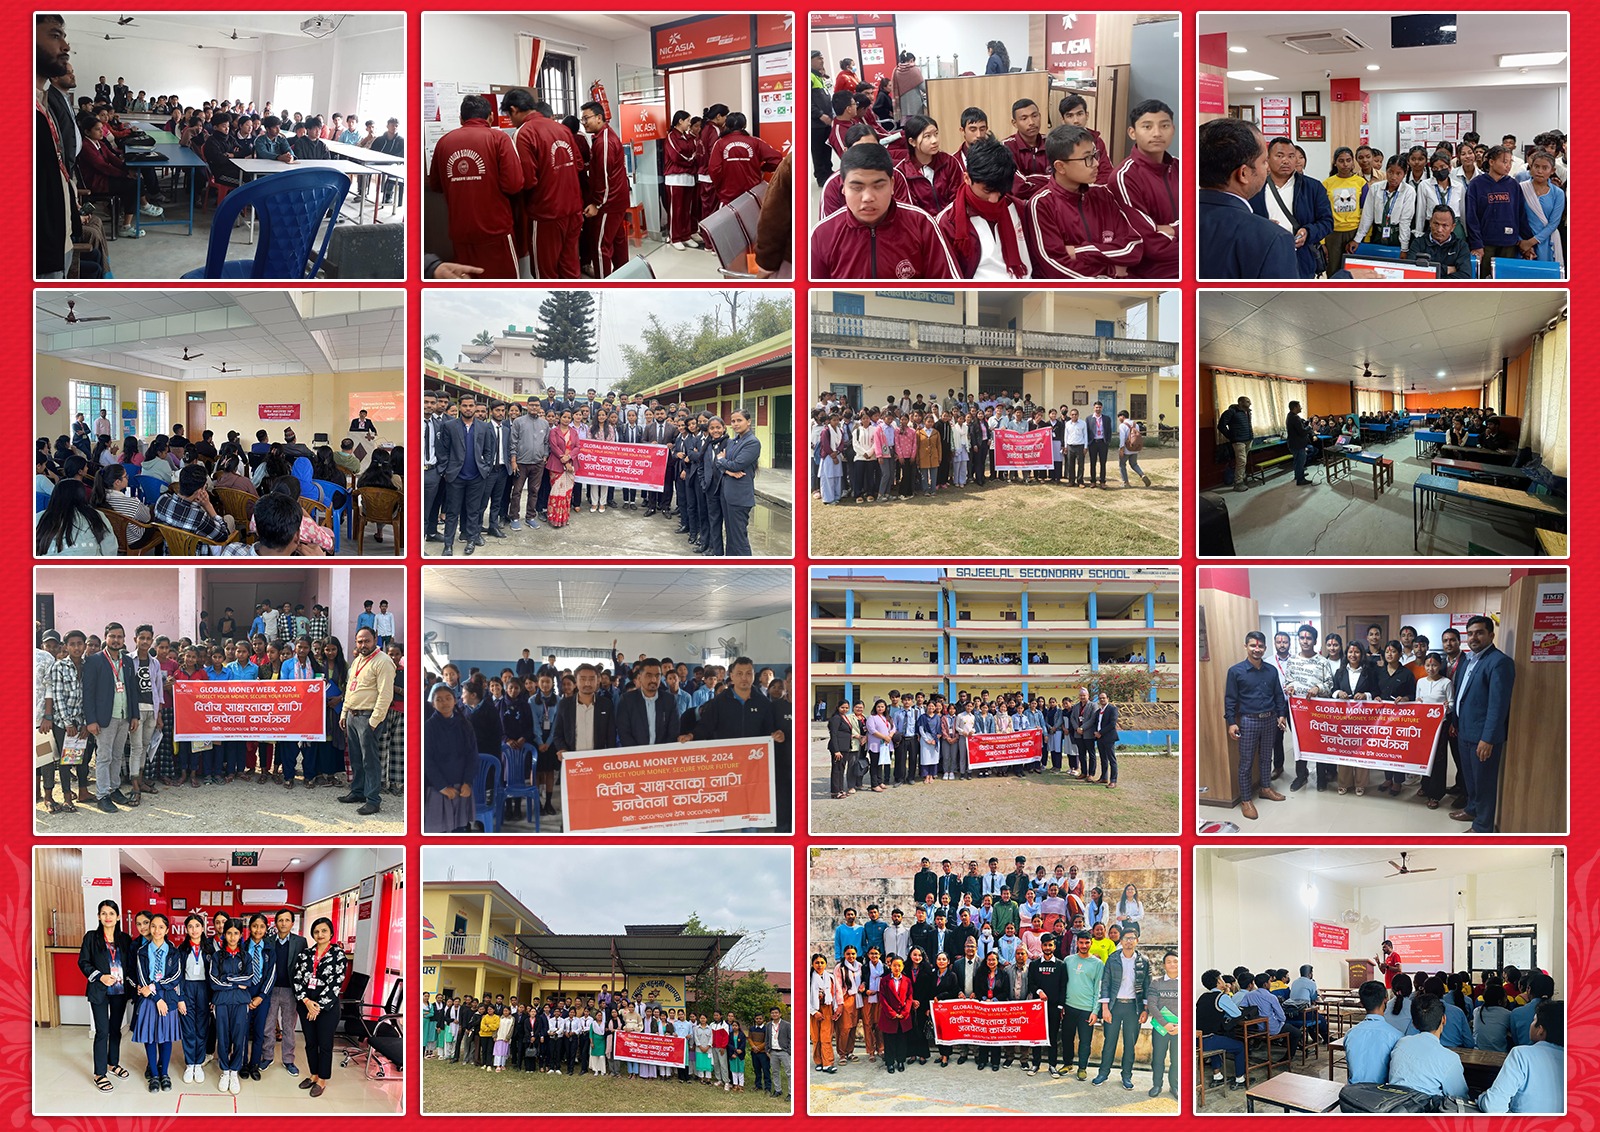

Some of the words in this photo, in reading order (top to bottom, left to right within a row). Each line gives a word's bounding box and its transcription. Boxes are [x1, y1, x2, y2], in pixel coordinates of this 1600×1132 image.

[660, 46, 672, 55] NIC
[674, 42, 696, 52] ASIA
[1052, 41, 1066, 55] NIC
[1066, 38, 1092, 54] ASIA
[634, 124, 644, 133] NIC
[644, 122, 657, 131] ASIA
[821, 348, 838, 358] श्री
[906, 354, 960, 365] माध्यमिक
[956, 568, 1014, 578] SAJEELAL
[1088, 568, 1130, 579] SCHOOL
[194, 701, 222, 712] वित्तीय
[225, 702, 274, 712] साक्षरताका
[277, 700, 302, 712] लागि
[1315, 706, 1344, 714] GLOBAL
[1345, 707, 1373, 715] MONEY
[1375, 708, 1397, 716] WEEK,
[1398, 708, 1415, 716] 2024
[205, 712, 246, 724] जनचेतना
[249, 712, 291, 724] कार्यक्रम
[1426, 708, 1440, 718] 26
[1310, 720, 1338, 733] वित्तीय
[1342, 724, 1393, 736] साक्षरताका
[1396, 725, 1422, 738] लागि
[1320, 734, 1363, 747] जनचेतना
[1366, 735, 1410, 751] कार्यक्रम
[748, 747, 764, 760] 26
[603, 761, 639, 771] GLOBAL
[643, 757, 678, 767] MONEY
[680, 754, 709, 764] WEEK,
[711, 752, 734, 761] 2024
[627, 769, 646, 777] YOUR
[696, 764, 715, 772] YOUR
[596, 782, 635, 798] वित्तीय
[640, 777, 706, 794] साक्षरताका
[710, 772, 742, 787] लागि
[612, 795, 668, 812] जनचेतना
[673, 789, 729, 807] कार्यक्रम
[236, 856, 254, 866] T20
